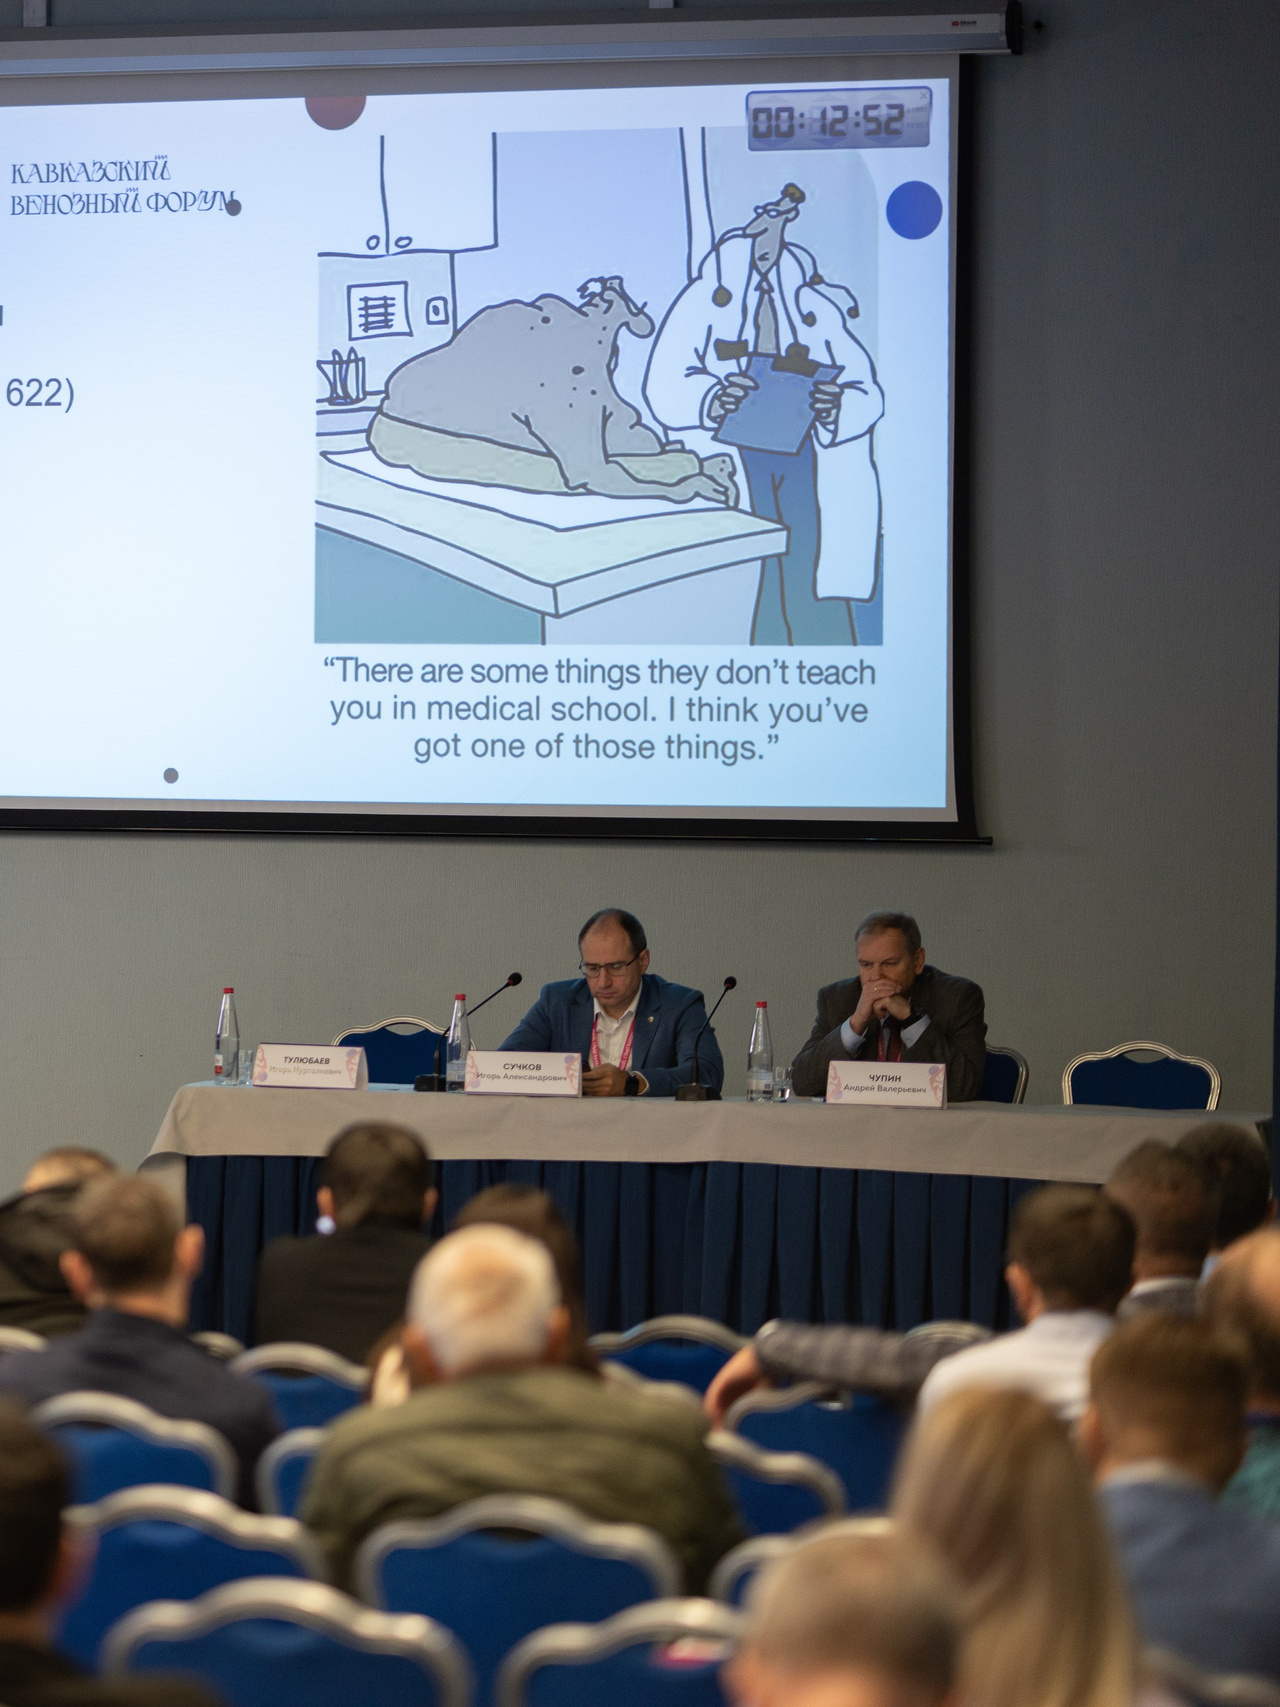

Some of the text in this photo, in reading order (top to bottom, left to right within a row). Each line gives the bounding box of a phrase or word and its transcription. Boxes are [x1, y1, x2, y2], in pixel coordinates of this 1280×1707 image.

[752, 103, 905, 139] 00:12:52
[11, 154, 171, 184] КАВКАЗСКИЙ
[10, 187, 142, 216] ВЕНОЗНЫЙ
[324, 656, 876, 691] “There are some things they don’t teach
[330, 694, 869, 729] you in medical school. I think you’ve
[414, 732, 779, 766] got one of those things.”
[284, 1056, 331, 1065] ТУЛЮБАЕВ
[503, 1062, 542, 1071] СУЧКОВ
[476, 1071, 567, 1083] Игорь Александрович
[843, 1083, 927, 1094] Андрей Валерьевич
[869, 1074, 902, 1083] ЧУПИН
